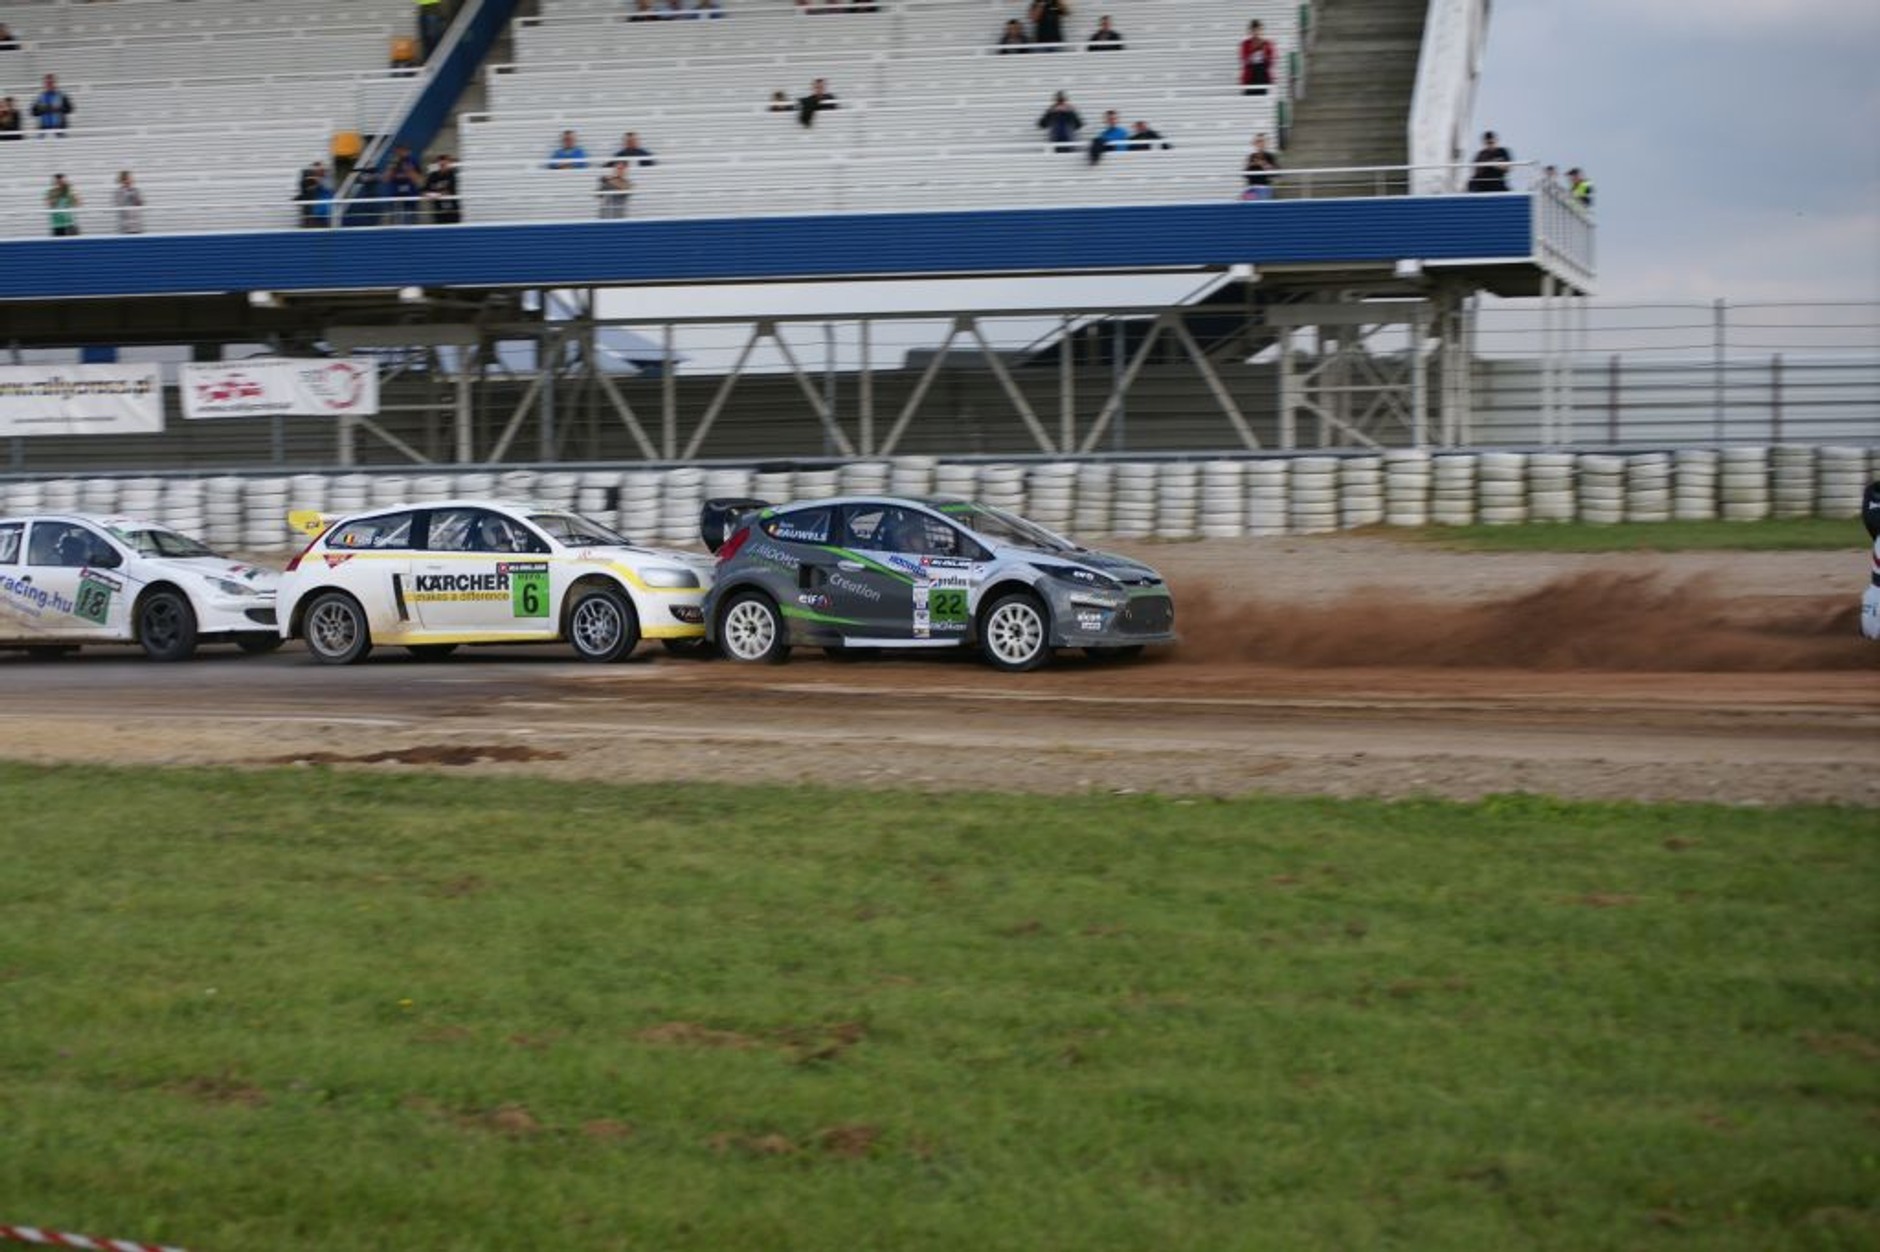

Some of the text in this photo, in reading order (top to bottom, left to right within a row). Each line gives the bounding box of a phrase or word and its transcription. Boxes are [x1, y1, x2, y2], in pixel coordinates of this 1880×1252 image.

[0, 574, 73, 614] racing.hu
[416, 574, 510, 592] KÄRCHER
[523, 582, 539, 614] 6
[829, 572, 882, 602] Creation
[78, 587, 106, 617] 18
[935, 594, 962, 615] 22
